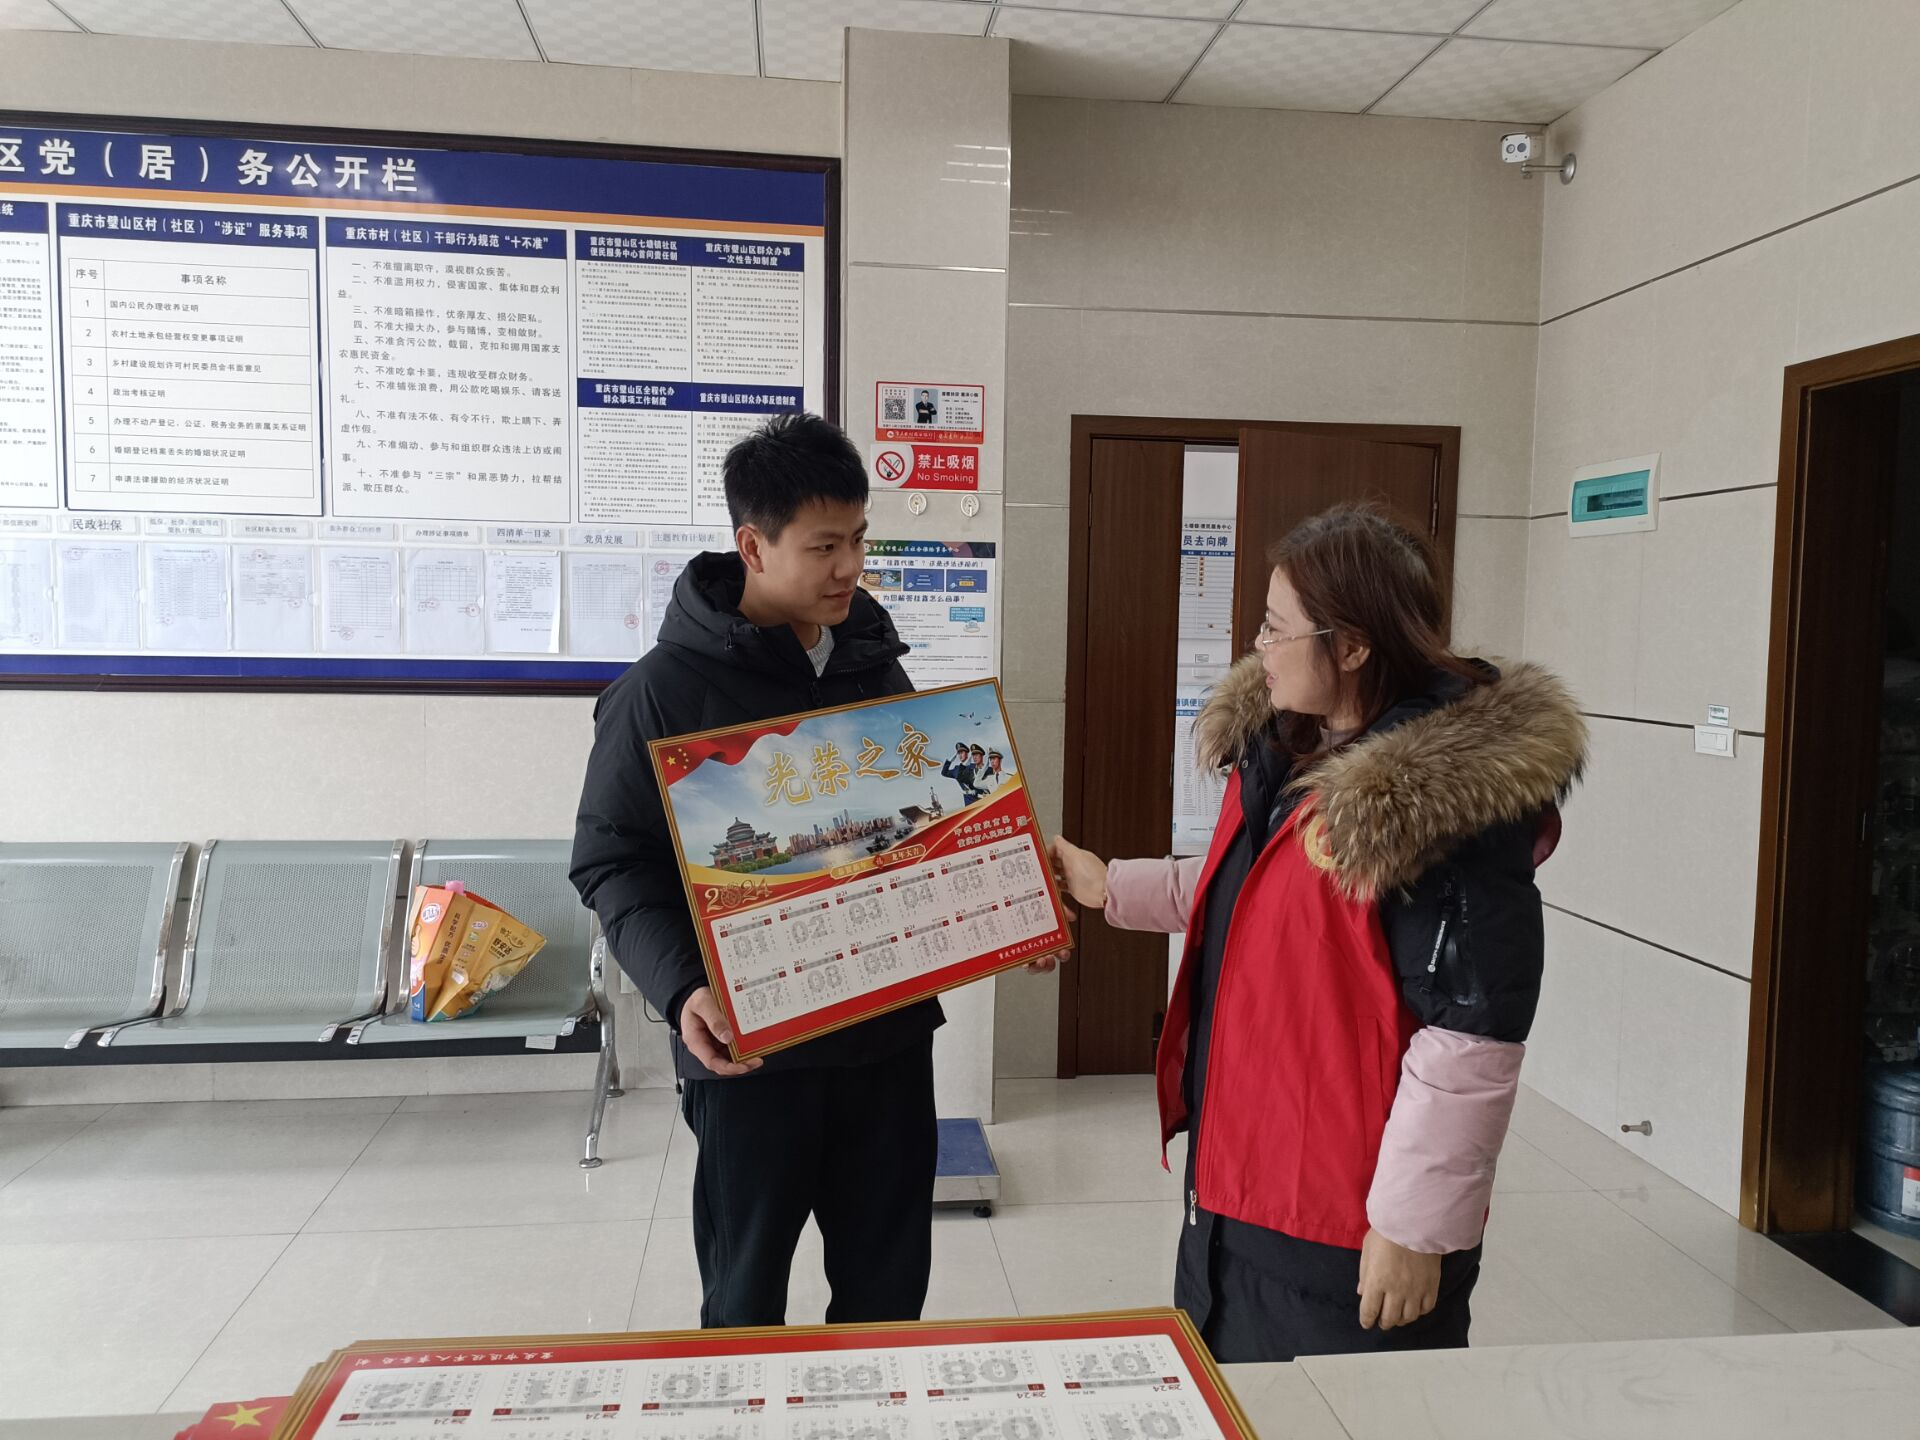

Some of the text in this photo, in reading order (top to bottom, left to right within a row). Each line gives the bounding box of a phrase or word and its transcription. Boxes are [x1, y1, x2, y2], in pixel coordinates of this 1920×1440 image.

[0, 203, 14, 216] 统
[718, 254, 778, 266] 一次性告知制度
[76, 268, 227, 286] 序号 事项名称
[85, 299, 199, 312] 1 国内公民办理收养证明
[85, 328, 244, 343] 2 农村土地承包经营权变更事项证明
[87, 358, 93, 367] 3
[87, 387, 166, 398] 4 政治考核证明
[88, 416, 95, 425] 5
[89, 445, 96, 454] 6
[918, 454, 975, 470] 禁止吸烟
[90, 474, 229, 486] 7 申请法律援助的经济状况证明
[917, 473, 974, 484] No Smoking
[72, 518, 123, 531] 民政社保
[496, 527, 551, 538] 四清单一目录
[654, 531, 715, 543] 主题教育计划表
[583, 534, 624, 545] 党员发展
[766, 722, 941, 807] 光荣之家
